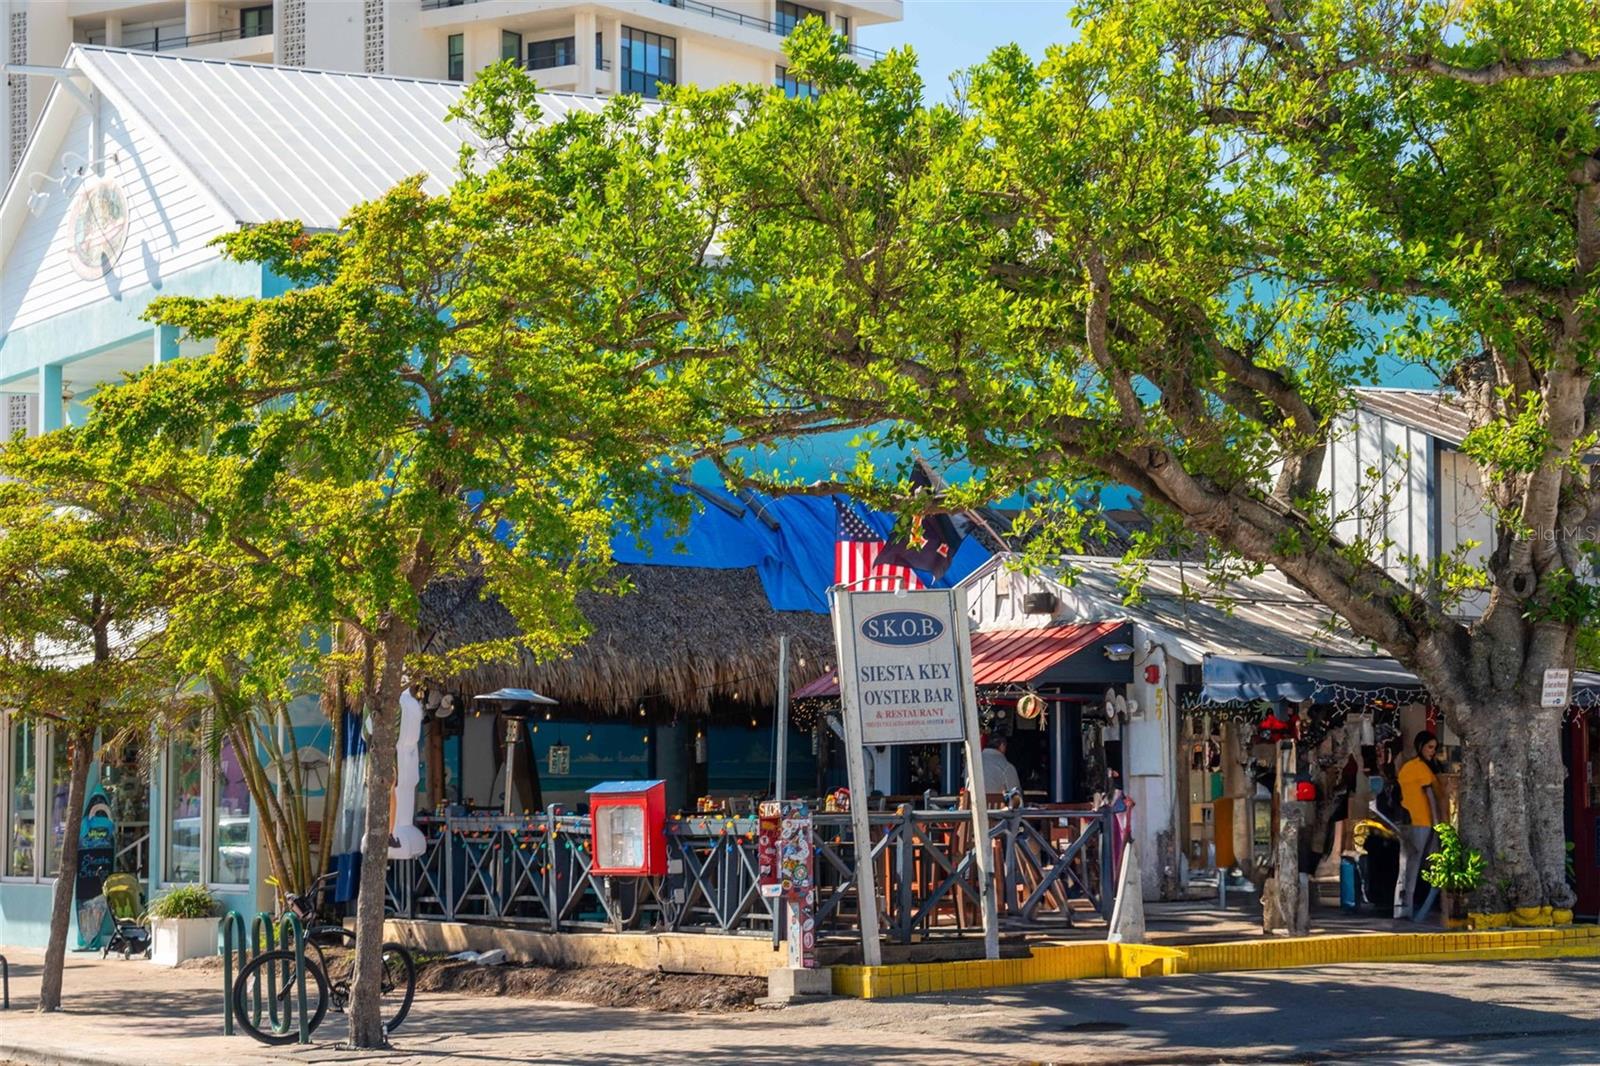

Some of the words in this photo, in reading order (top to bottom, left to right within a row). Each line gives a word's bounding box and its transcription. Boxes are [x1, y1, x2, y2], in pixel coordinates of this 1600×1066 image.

[868, 618, 938, 638] S.K.O.B.
[861, 664, 915, 683] SIESTA
[919, 663, 951, 680] KEY
[864, 689, 921, 705] OYSTER
[924, 688, 953, 703] BAR
[885, 708, 945, 719] RESTAURANT
